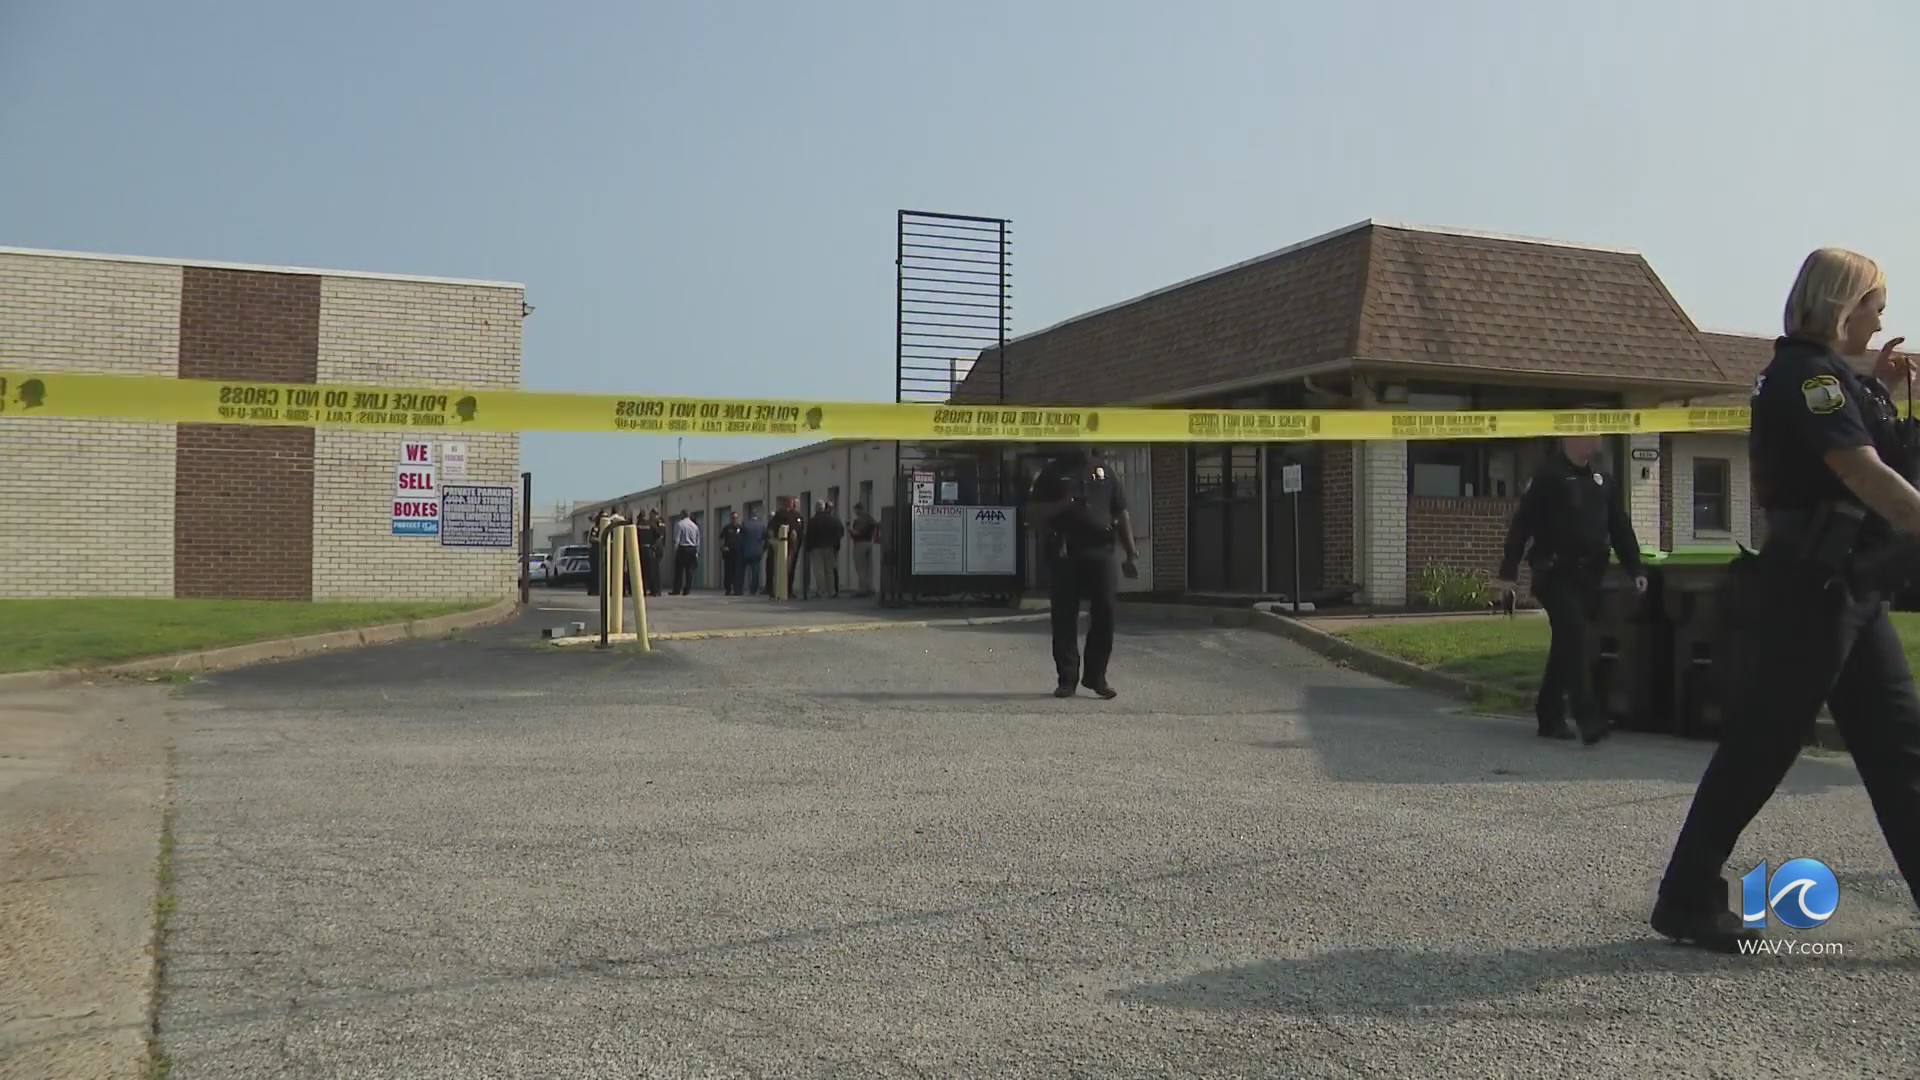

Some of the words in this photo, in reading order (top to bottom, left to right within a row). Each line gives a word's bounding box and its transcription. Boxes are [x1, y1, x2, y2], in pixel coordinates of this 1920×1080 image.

[406, 444, 428, 461] WE
[399, 473, 433, 489] SELL
[394, 502, 438, 517] BOXES
[915, 506, 961, 515] ATTENTION
